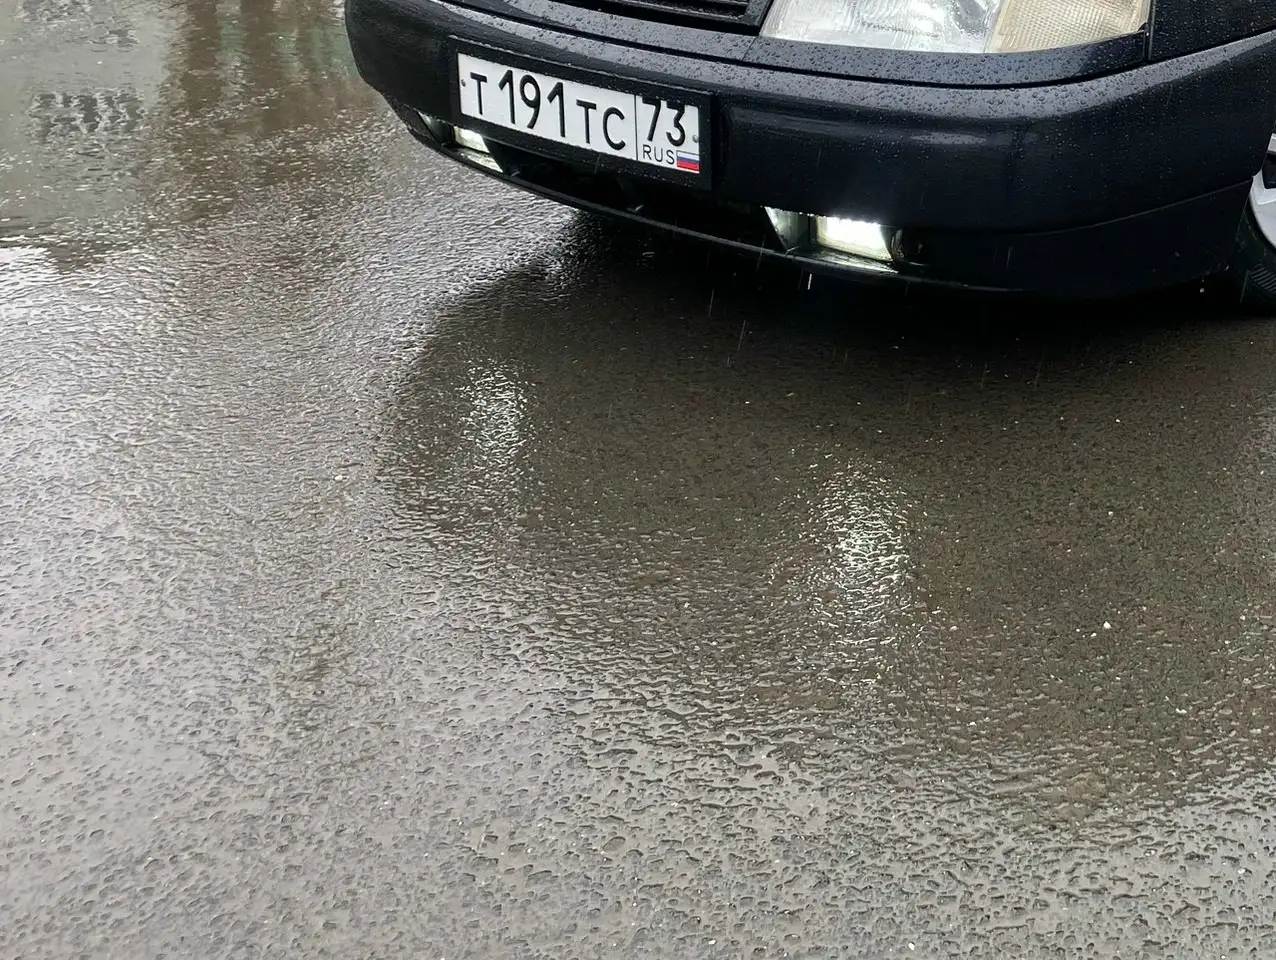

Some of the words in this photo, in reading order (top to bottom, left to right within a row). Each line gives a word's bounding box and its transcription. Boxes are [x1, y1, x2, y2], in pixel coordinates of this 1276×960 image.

[470, 69, 626, 150] Т191ТС
[642, 96, 687, 147] 73
[642, 144, 675, 165] RUS
